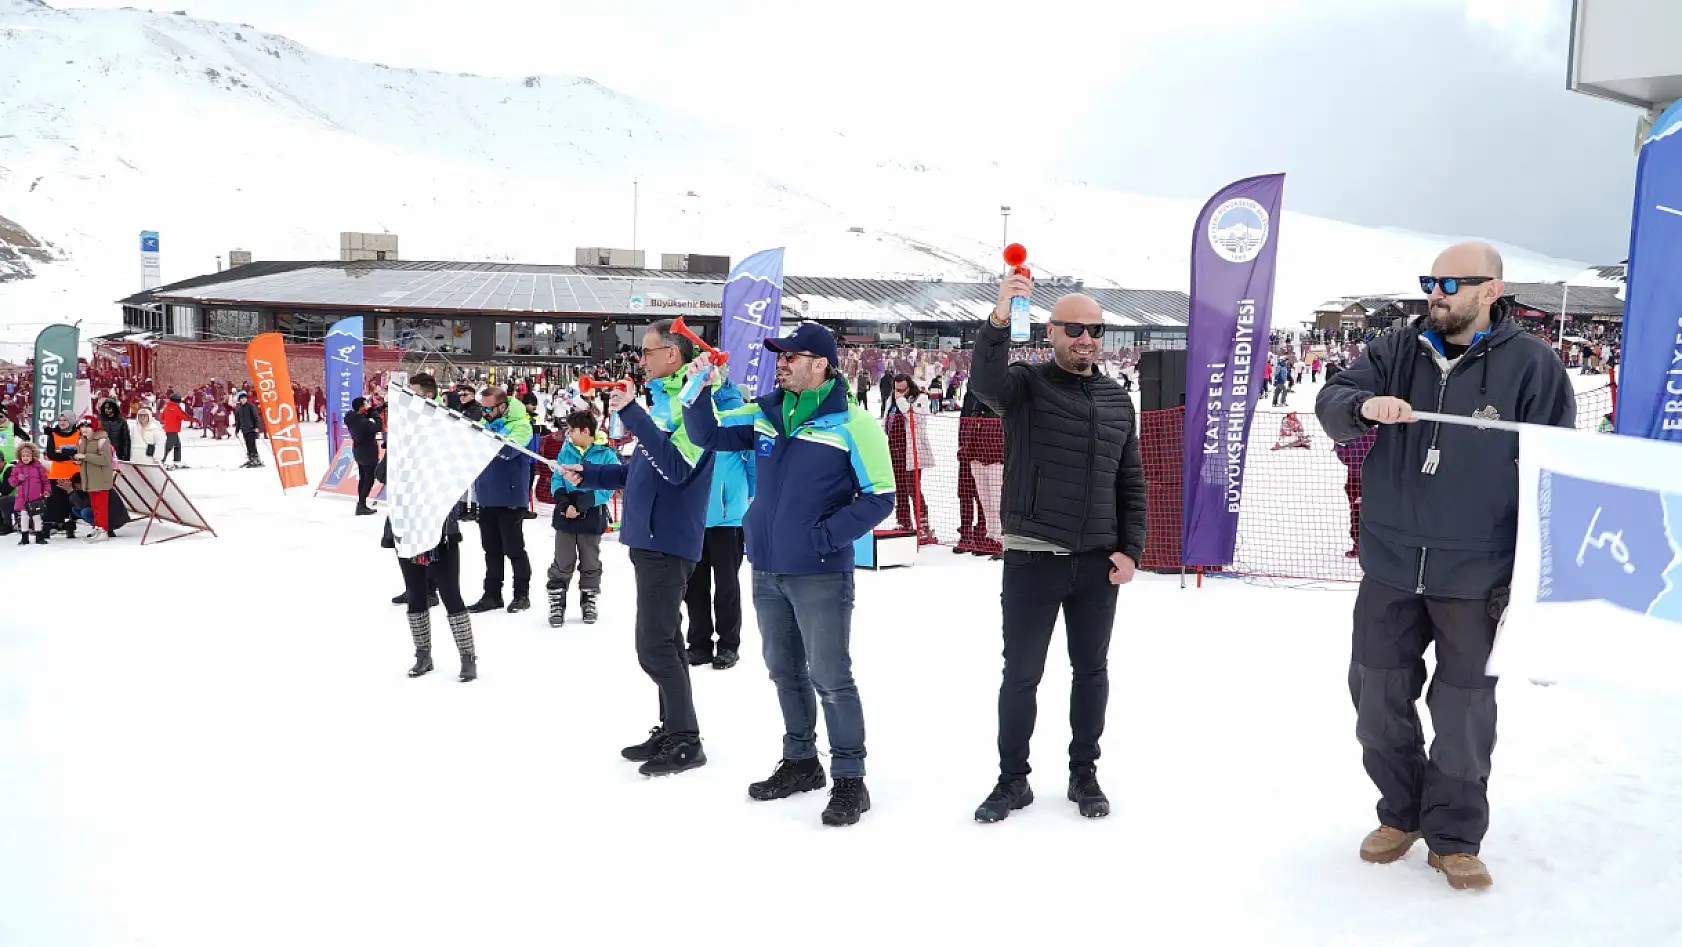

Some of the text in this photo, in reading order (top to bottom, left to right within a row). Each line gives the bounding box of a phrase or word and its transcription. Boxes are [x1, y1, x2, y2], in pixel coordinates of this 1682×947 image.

[700, 300, 723, 308] Beled
[253, 359, 304, 468] DAS 3917
[1203, 363, 1226, 454] KAYSERİ
[1225, 299, 1255, 513] BÜYÜKŞEHİR BELEDİYESİ
